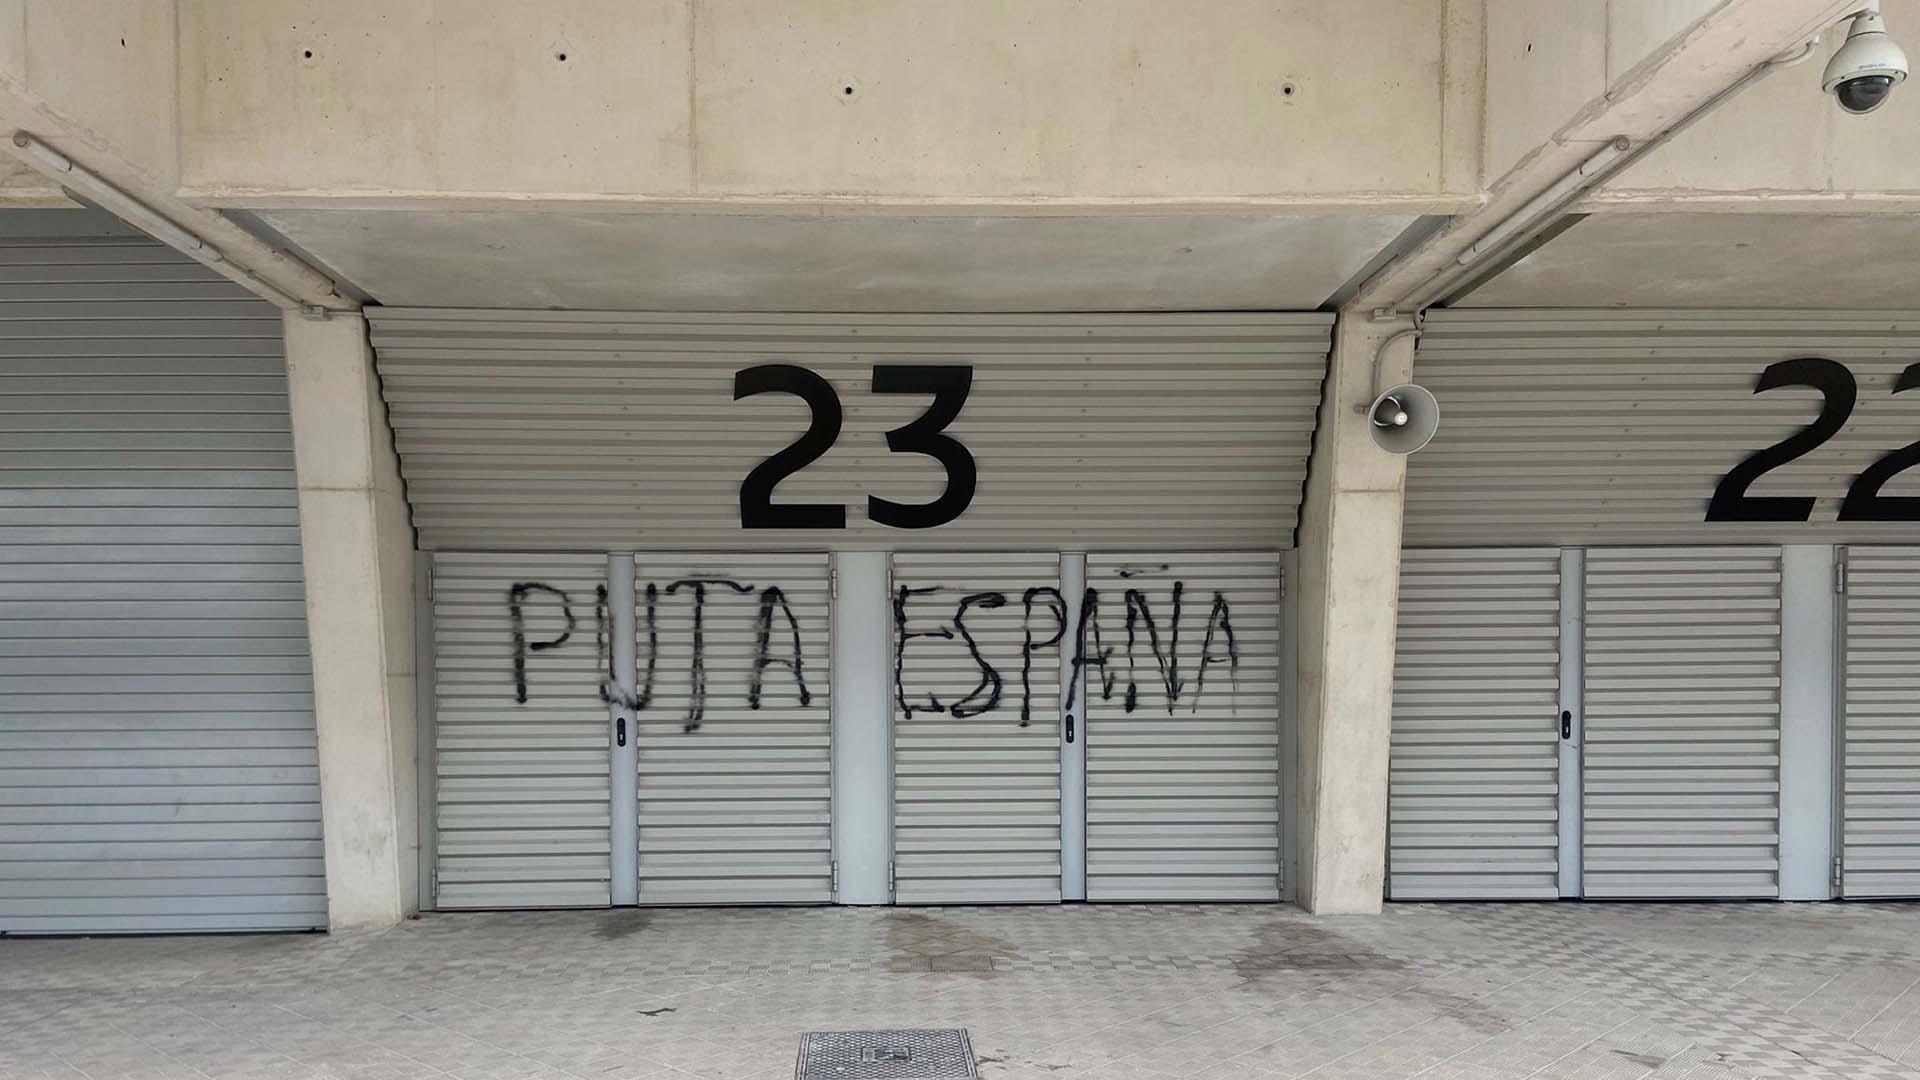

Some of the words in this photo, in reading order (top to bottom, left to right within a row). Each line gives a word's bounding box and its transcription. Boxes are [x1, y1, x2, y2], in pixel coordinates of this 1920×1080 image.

[733, 364, 977, 529] 23
[509, 575, 812, 734] PUTA
[892, 564, 1239, 727] ESPAÑA
